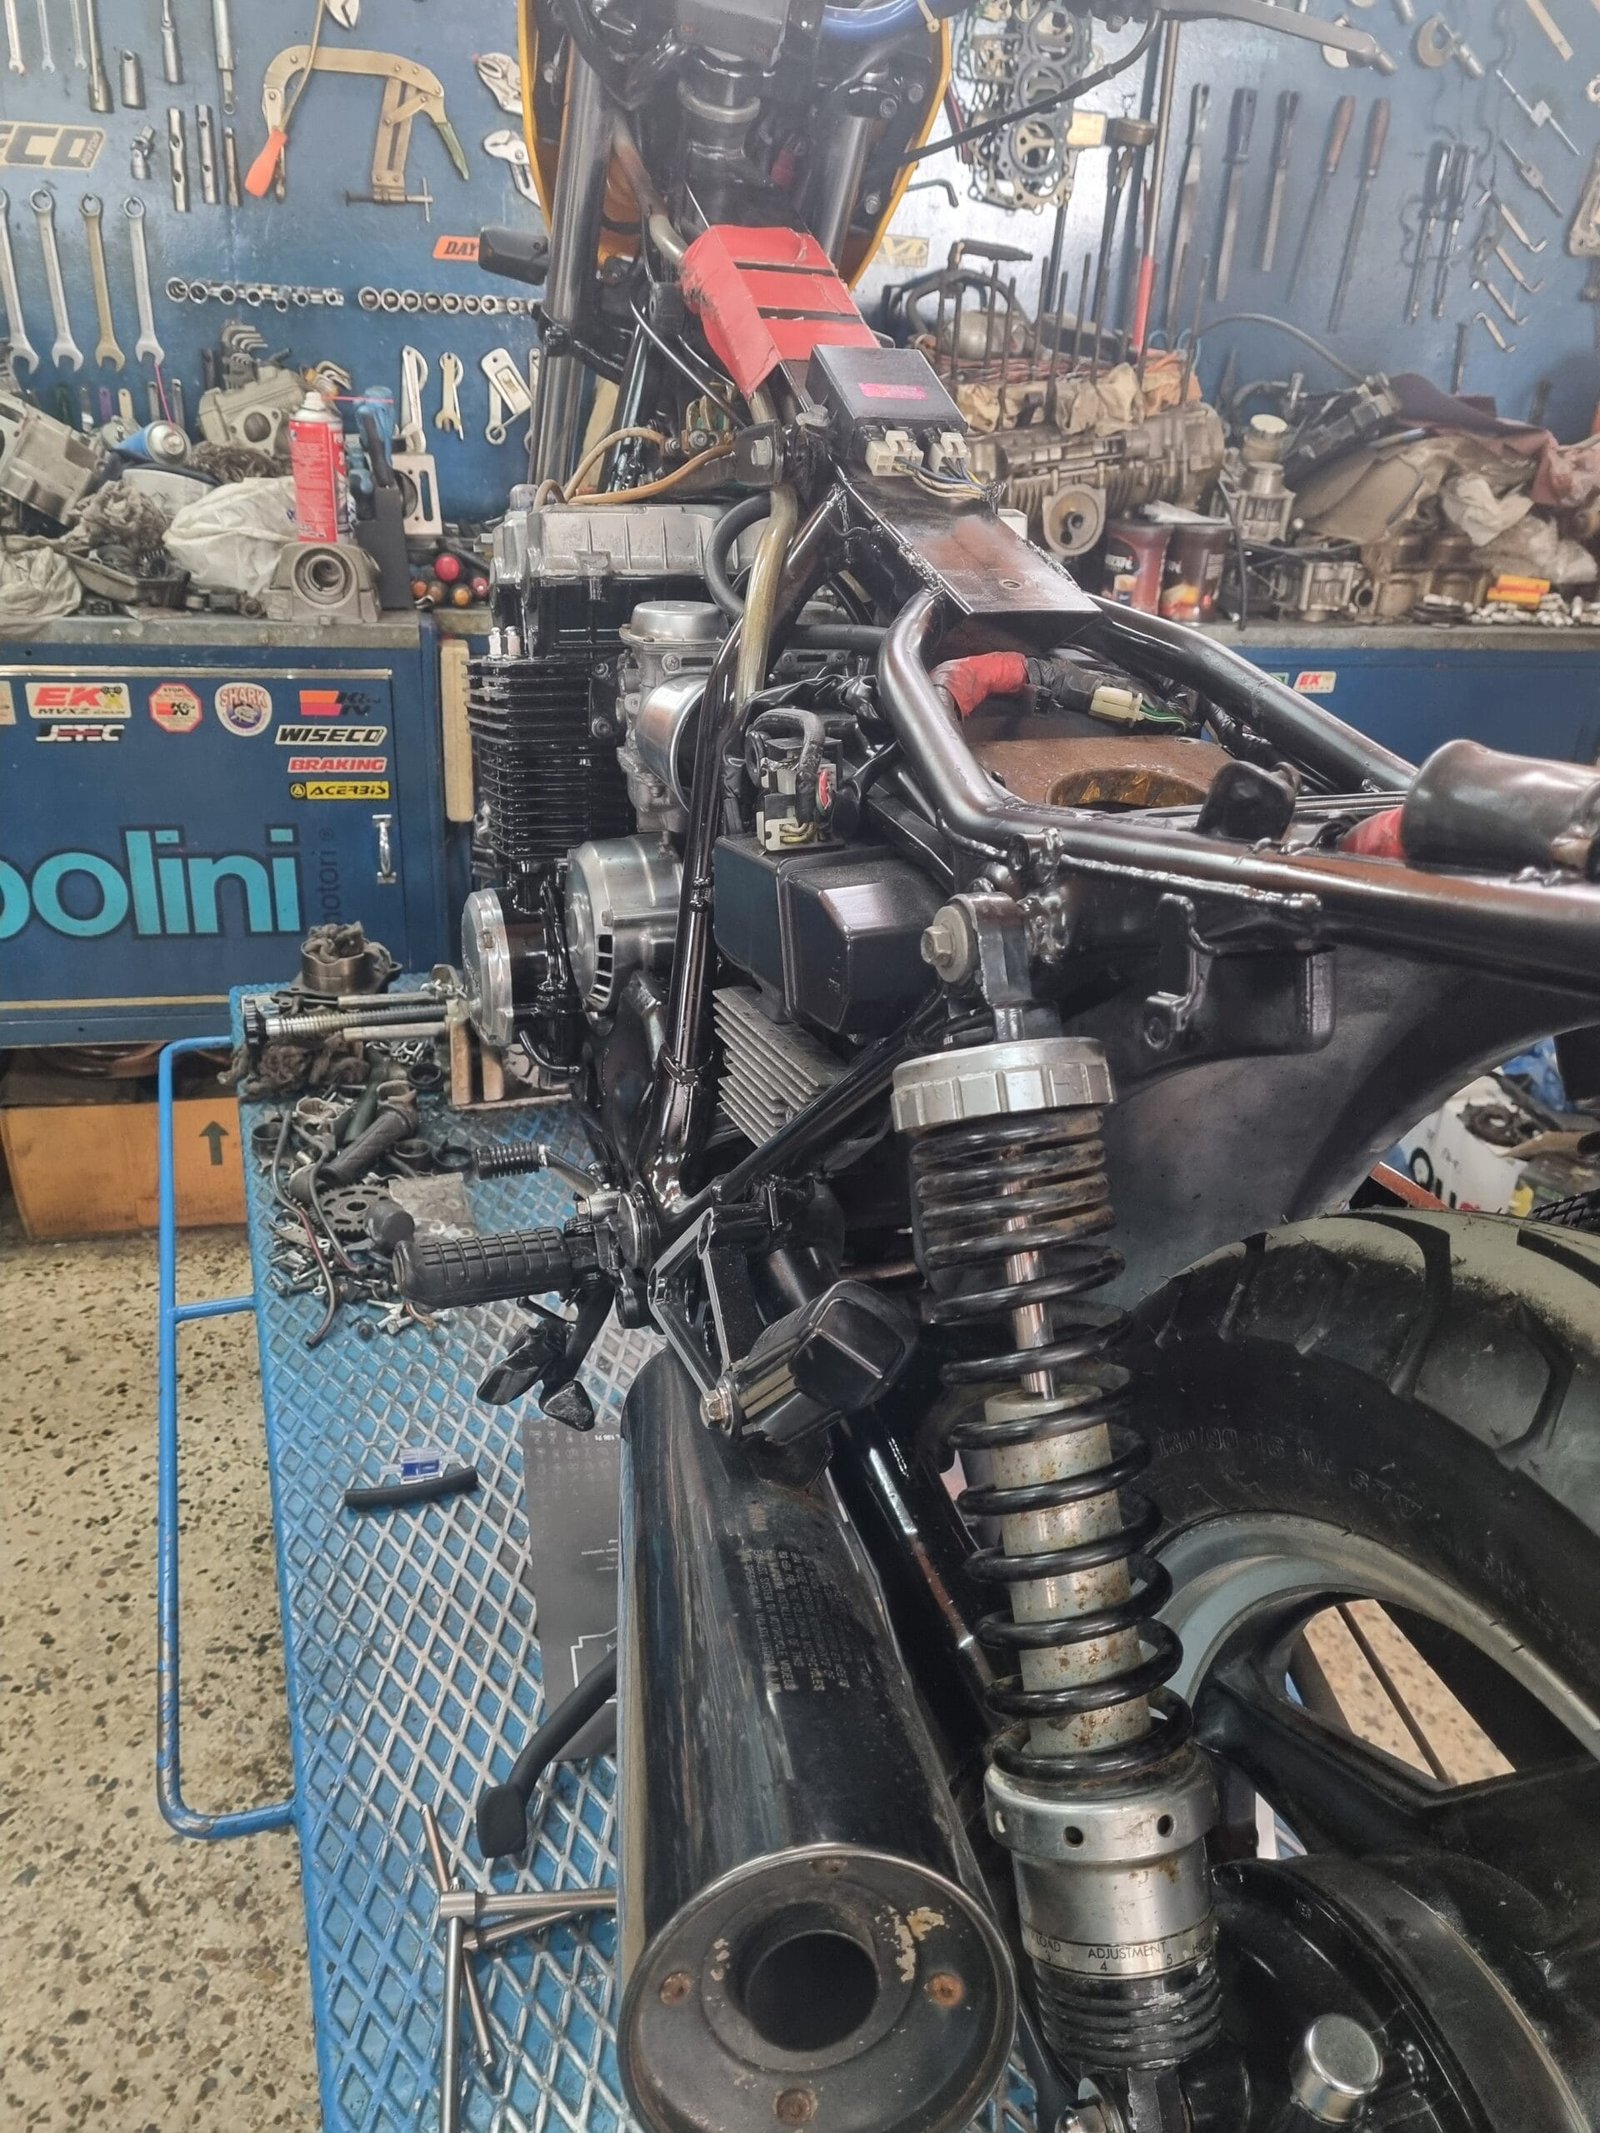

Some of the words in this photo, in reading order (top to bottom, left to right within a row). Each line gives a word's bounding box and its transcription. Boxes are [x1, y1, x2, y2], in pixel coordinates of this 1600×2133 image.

[34, 686, 102, 707] EK
[279, 728, 384, 742] WISECO
[290, 759, 385, 771] BRAKING
[1088, 1941, 1167, 1960] ADJUSTMENT
[1100, 1962, 1108, 1972] 4
[1166, 1953, 1173, 1966] 5
